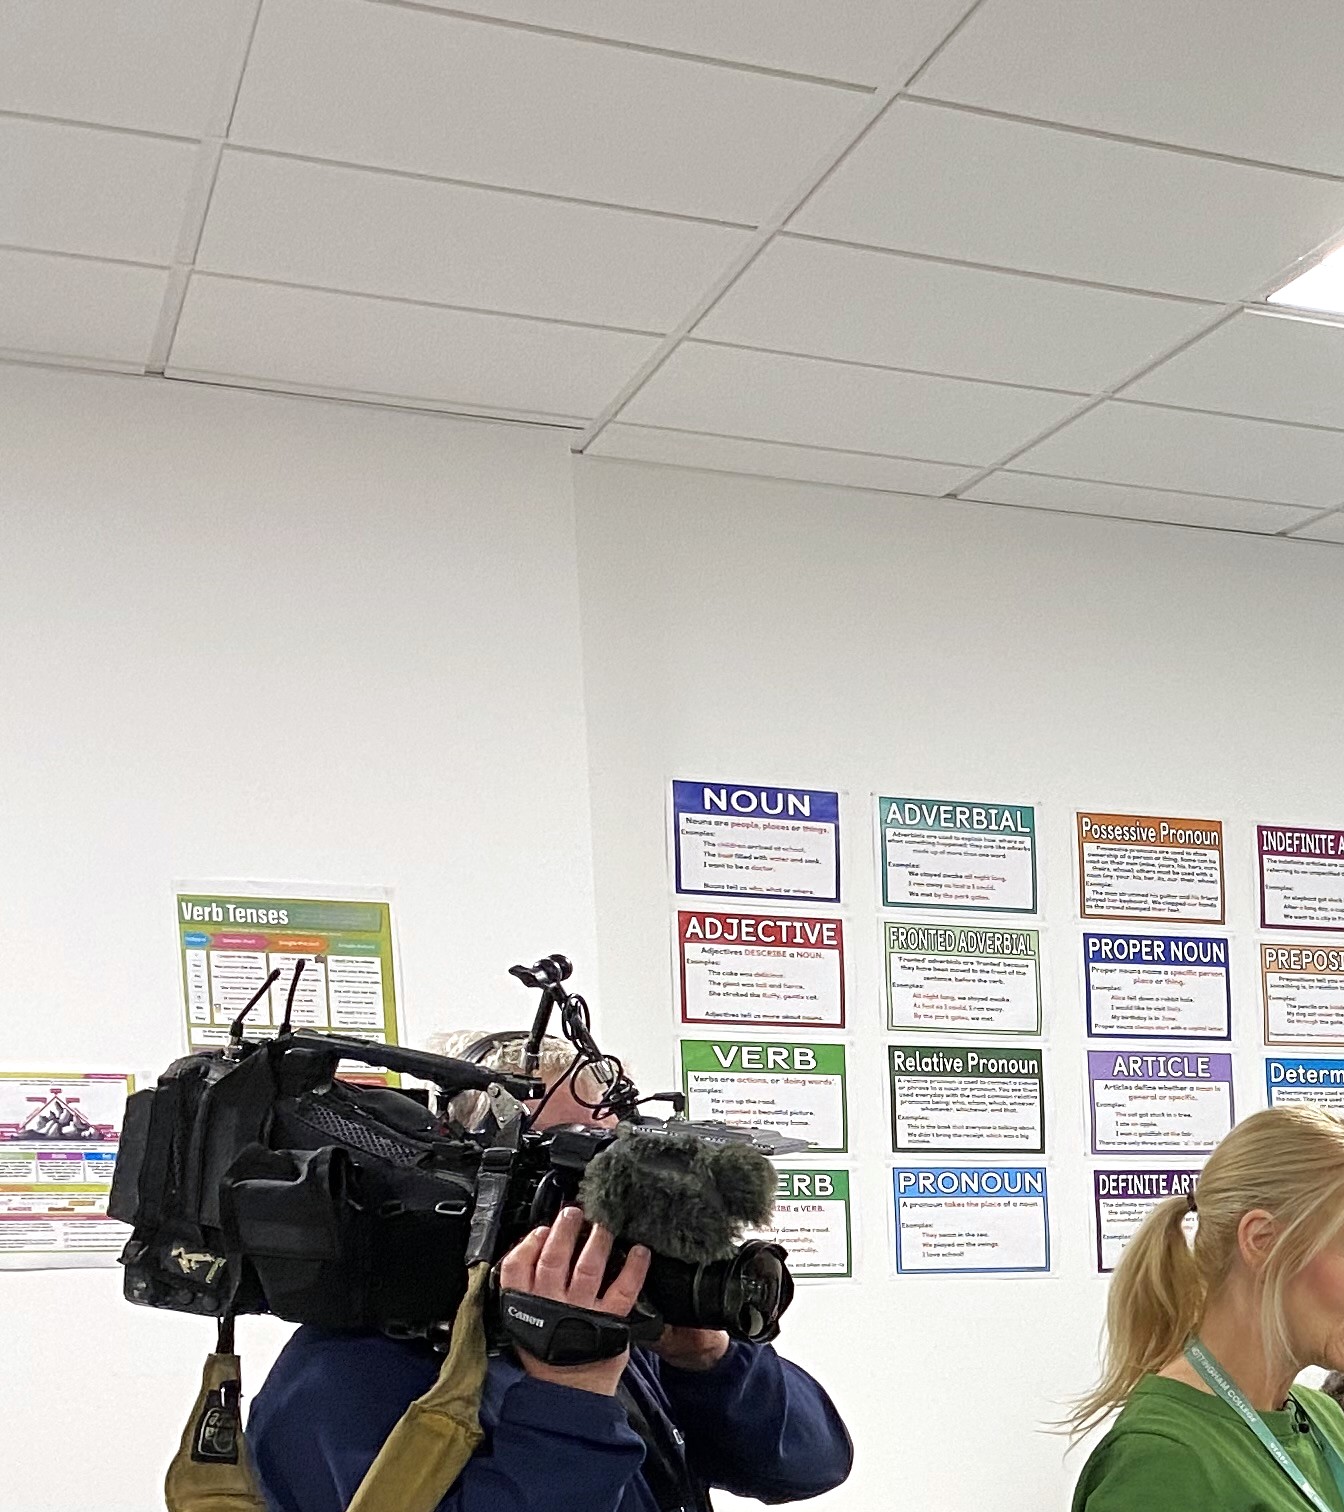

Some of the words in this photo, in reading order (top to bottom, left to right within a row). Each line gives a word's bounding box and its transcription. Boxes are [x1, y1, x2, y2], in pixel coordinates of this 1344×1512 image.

[703, 787, 810, 817] NOUN
[686, 817, 712, 826] Nouns
[731, 821, 761, 830] people,
[763, 823, 789, 831] places
[887, 803, 1030, 832] ADVERBIAL
[1082, 817, 1156, 842] Possessive
[1160, 823, 1218, 845] Pronoun
[1262, 831, 1335, 854] INDEFINITE
[181, 901, 223, 922] Verb
[226, 904, 289, 925] Tenses
[686, 916, 837, 945] ADJECTIVE
[890, 927, 955, 951] FRONTED
[958, 930, 1035, 956] ADVERBIAL
[701, 947, 742, 957] Adjectives
[744, 949, 786, 957] DESCRIBE
[1089, 938, 1165, 961] PROPER
[1171, 941, 1225, 963] NOUN
[712, 1045, 817, 1070] VERB
[894, 1051, 963, 1072] Relative
[967, 1053, 1038, 1073] Pronoun
[1113, 1056, 1211, 1077] ARTICLE
[694, 1075, 718, 1083] Verbs
[775, 1174, 833, 1196] ERB
[900, 1172, 1042, 1193] PRONOUN
[1099, 1175, 1168, 1195] DEFINITE
[981, 1201, 1001, 1209] place
[507, 1304, 545, 1329] Canon
